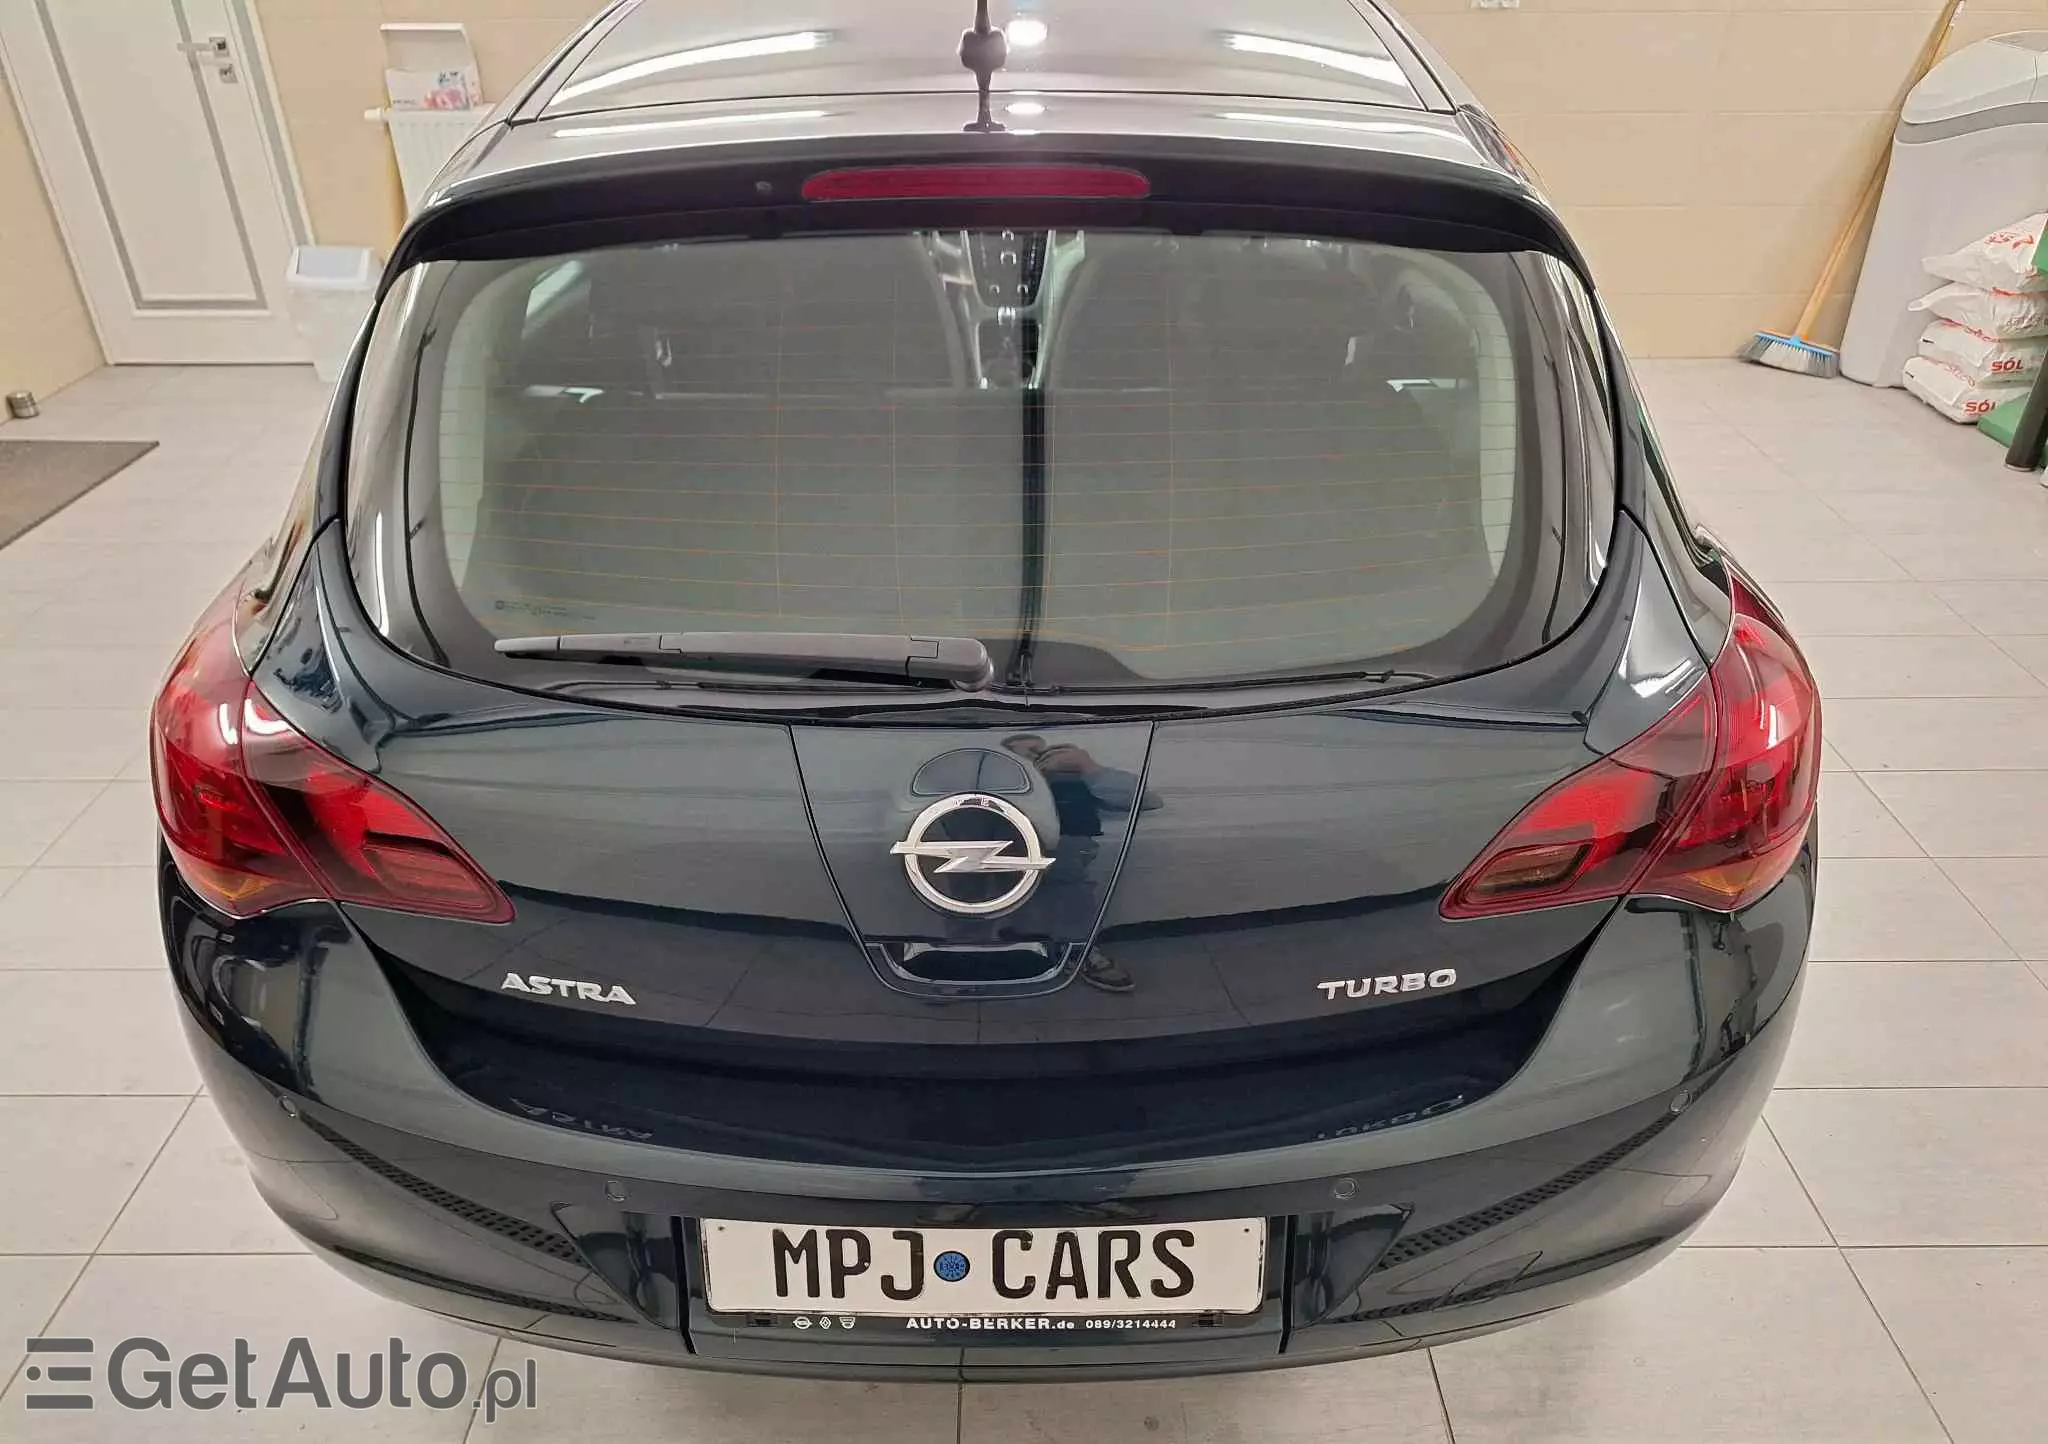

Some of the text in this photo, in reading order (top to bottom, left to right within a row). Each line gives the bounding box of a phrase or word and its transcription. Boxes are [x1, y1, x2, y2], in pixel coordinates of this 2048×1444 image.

[1991, 357, 2024, 372] SÓL
[501, 972, 637, 1005] ASTRA
[1317, 968, 1457, 1000] TURBO
[772, 1228, 1195, 1300] MPJ CARS
[905, 1316, 1177, 1330] AUTO-BERKER.de 089/3214444
